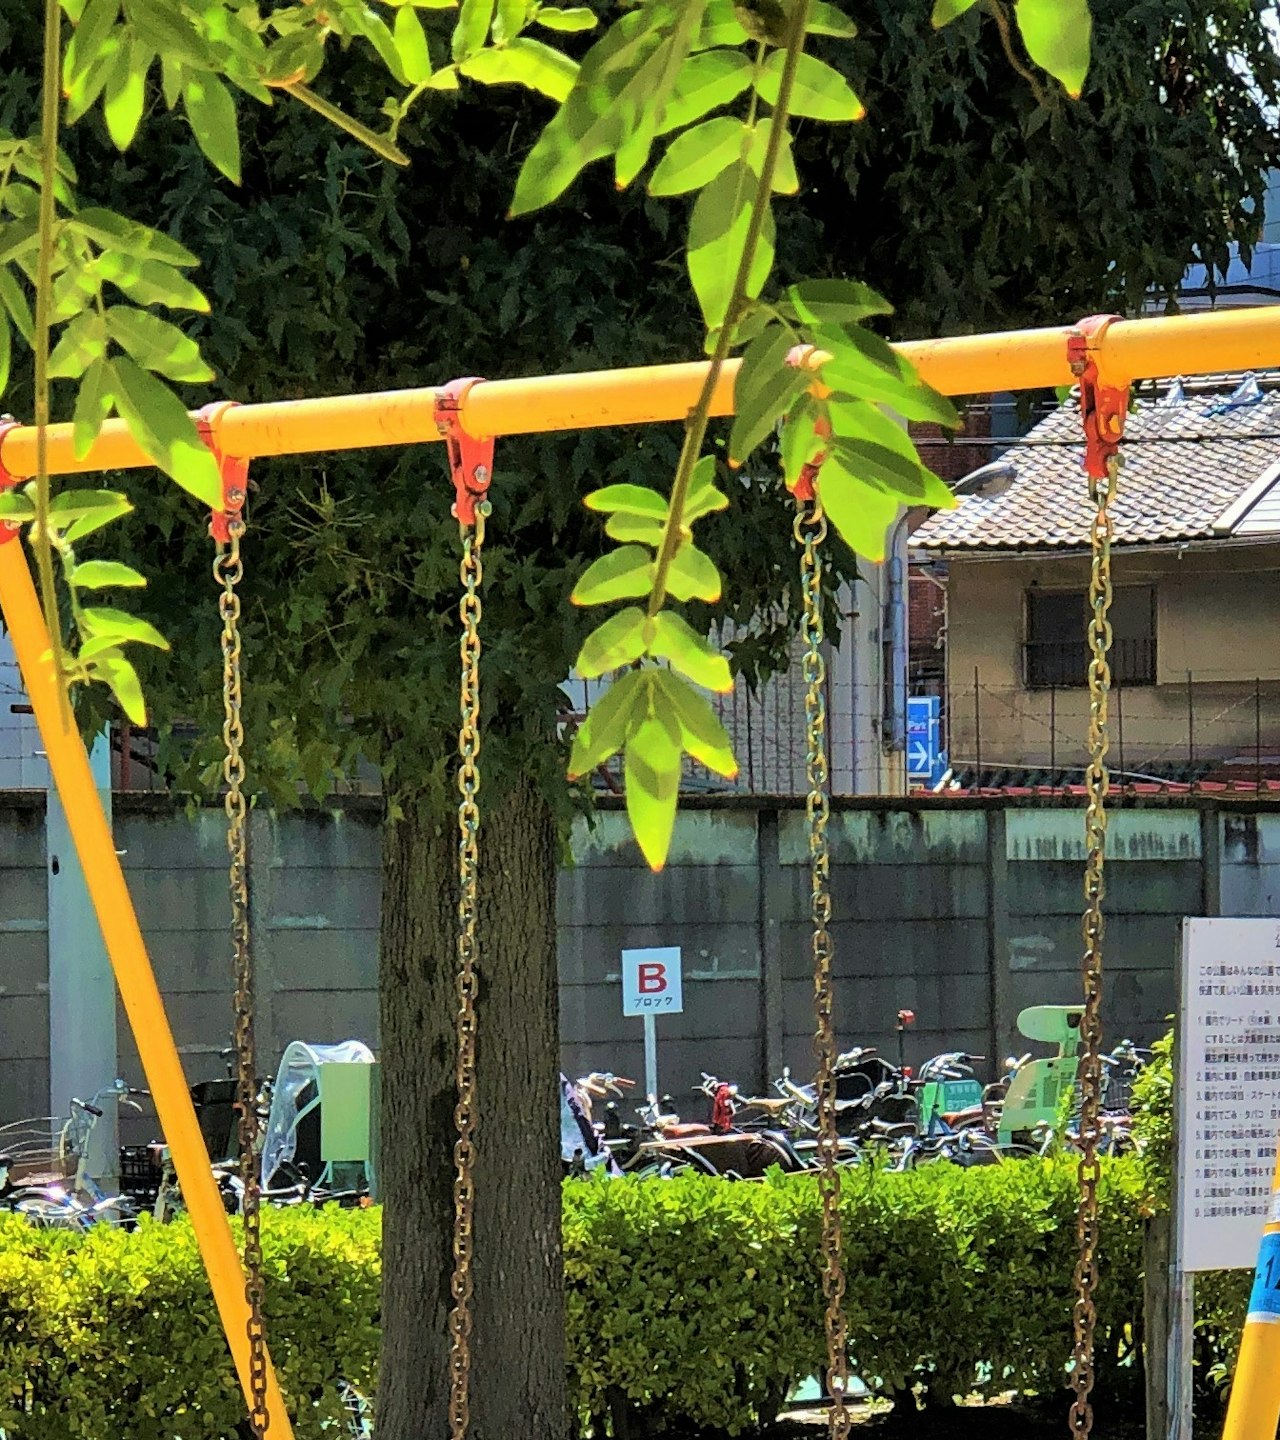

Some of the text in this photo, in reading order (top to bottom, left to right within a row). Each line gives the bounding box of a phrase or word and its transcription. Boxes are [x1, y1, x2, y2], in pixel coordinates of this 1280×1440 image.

[638, 963, 667, 993] B
[633, 996, 673, 1008] ブロック
